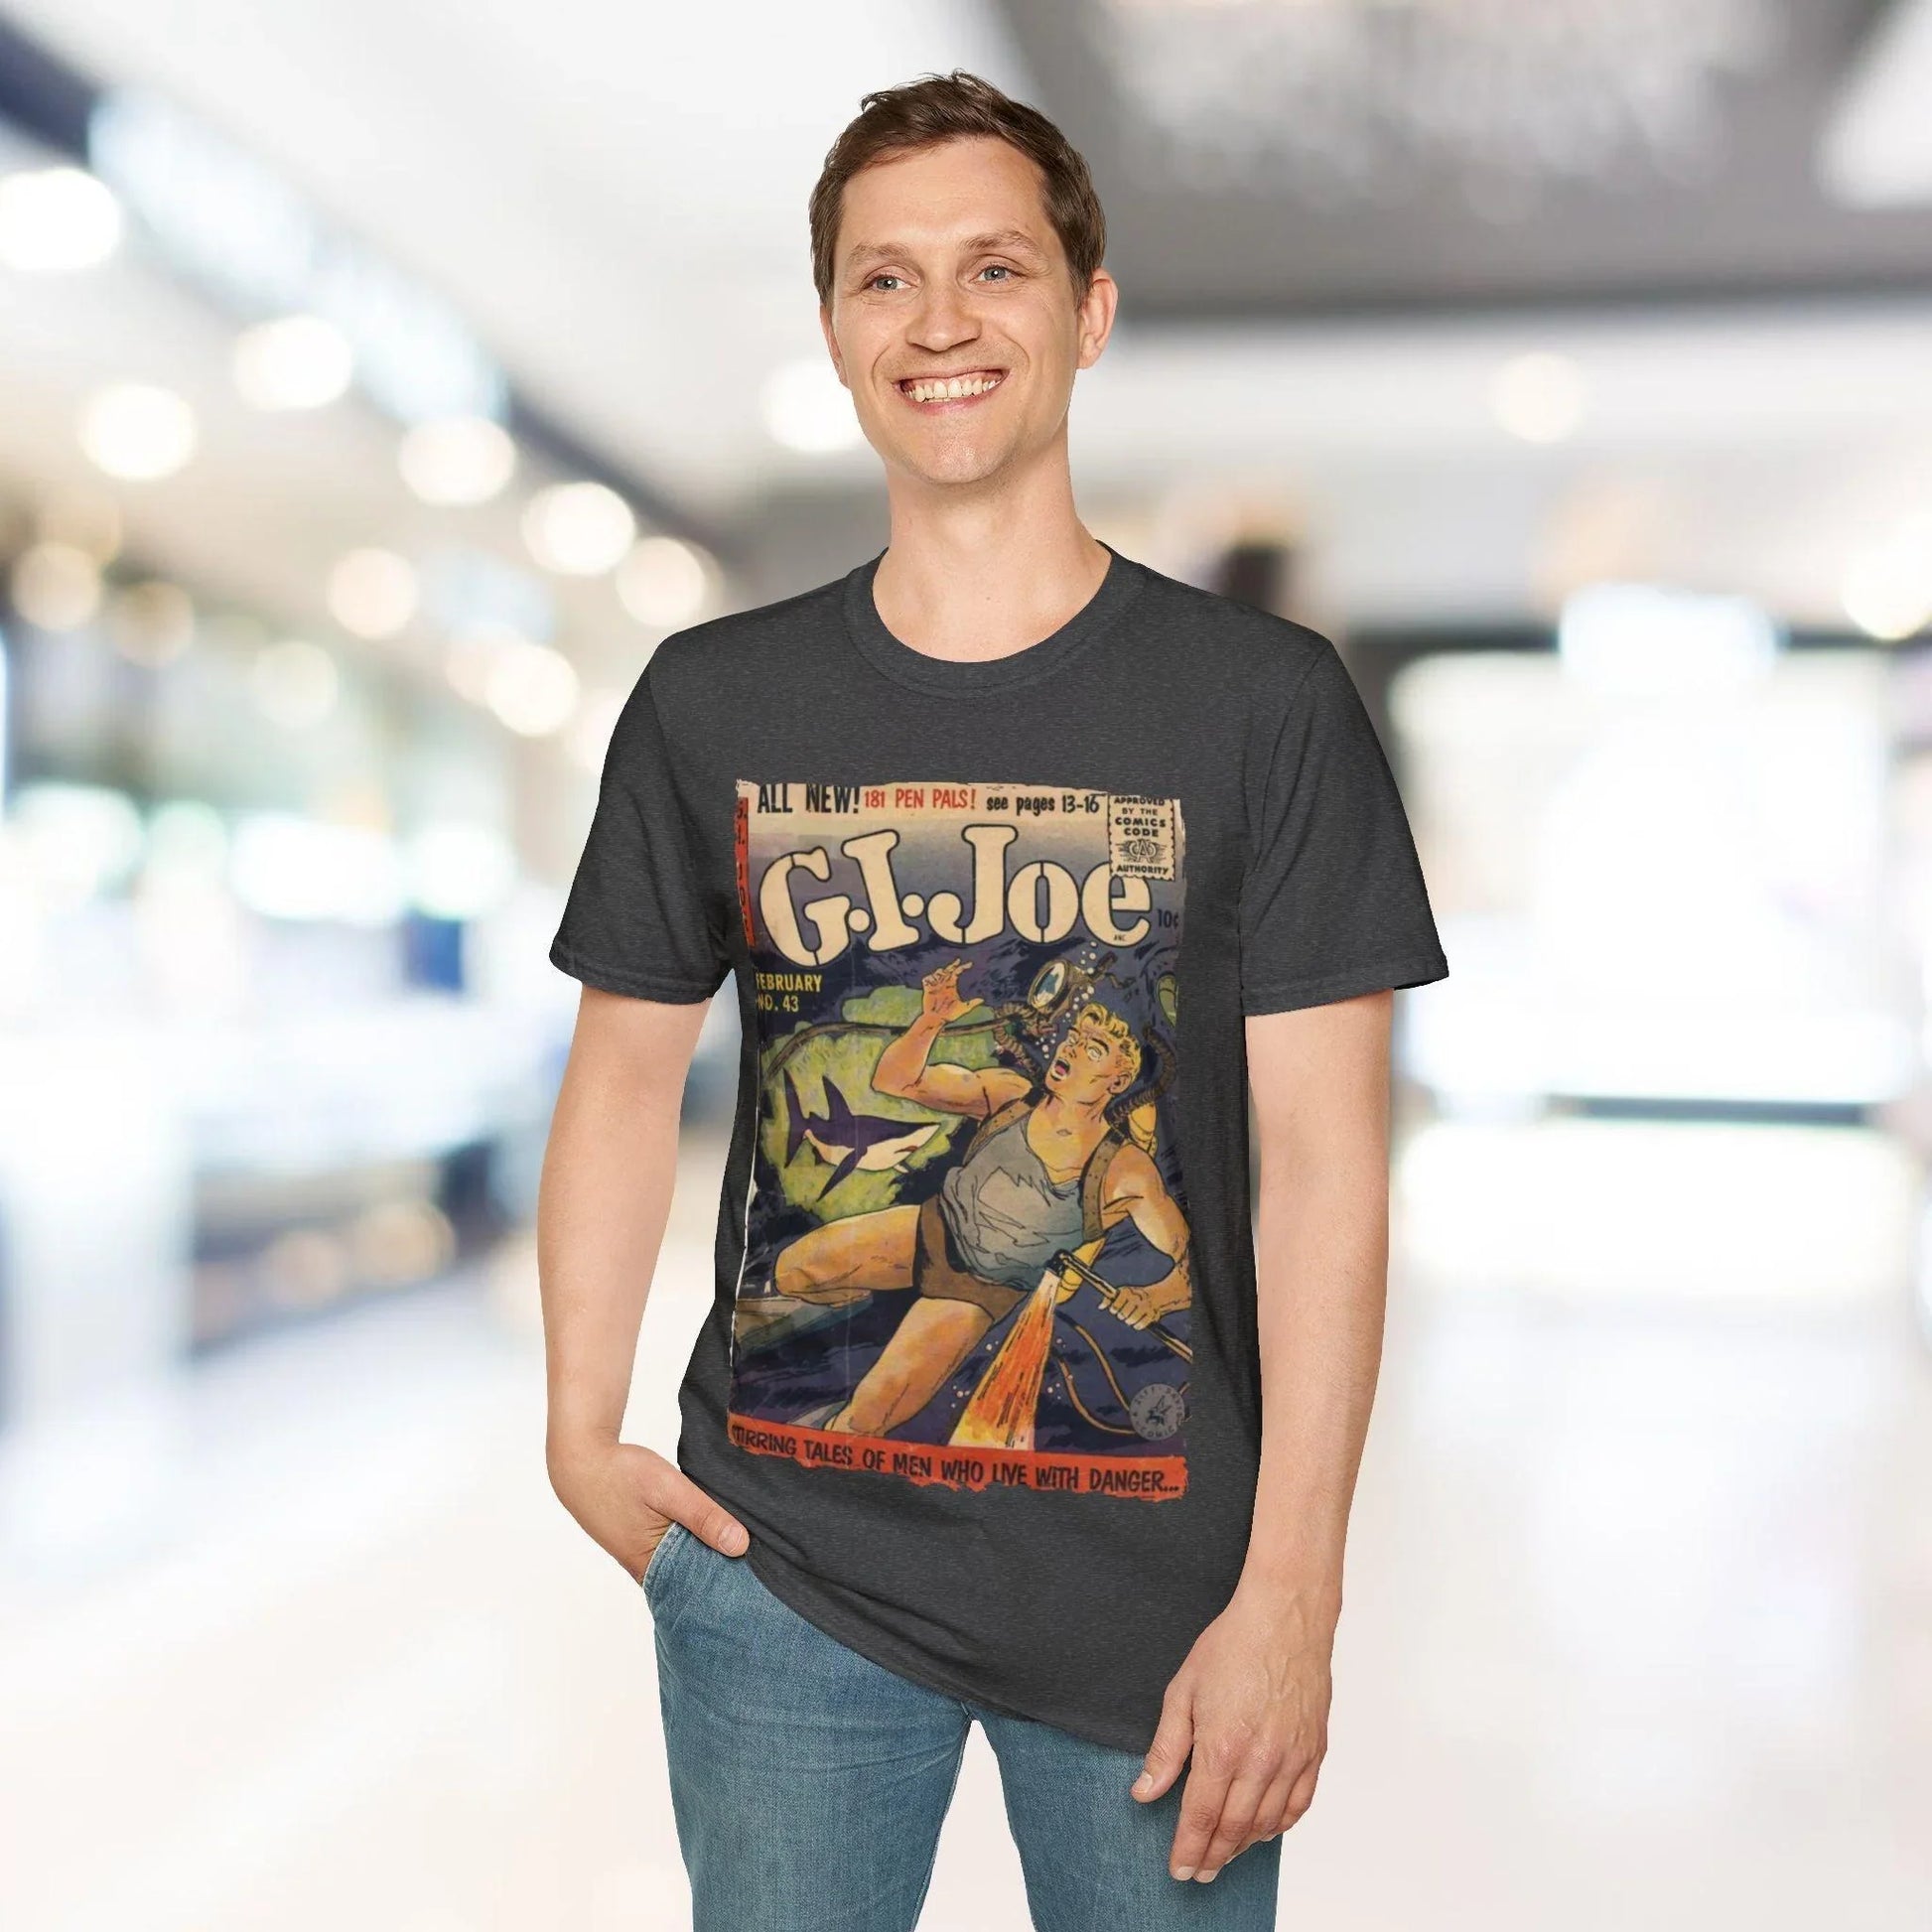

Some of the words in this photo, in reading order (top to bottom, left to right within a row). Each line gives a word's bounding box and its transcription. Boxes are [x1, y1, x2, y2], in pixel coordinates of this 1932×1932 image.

[758, 783, 793, 813] ALL
[806, 784, 860, 813] NEW!
[865, 790, 886, 808] 181
[896, 789, 924, 808] PEN
[932, 789, 976, 809] PALS!
[986, 796, 1009, 812] see
[1016, 796, 1055, 817] pages
[1061, 795, 1100, 814] 13-16
[1114, 796, 1166, 806] APPROVED
[1140, 807, 1159, 816] THE
[1115, 817, 1167, 828] COMICS
[1124, 827, 1160, 838] CODE
[1116, 864, 1170, 876] AUTHORITY
[782, 995, 799, 1012] 43
[804, 1440, 853, 1466] TALES
[862, 1449, 886, 1469] OF
[894, 1453, 931, 1478] MEN
[941, 1459, 984, 1483] WHO
[993, 1462, 1027, 1485] LIVE
[1035, 1466, 1079, 1489] WITH
[1089, 1467, 1179, 1492] DANGER...
